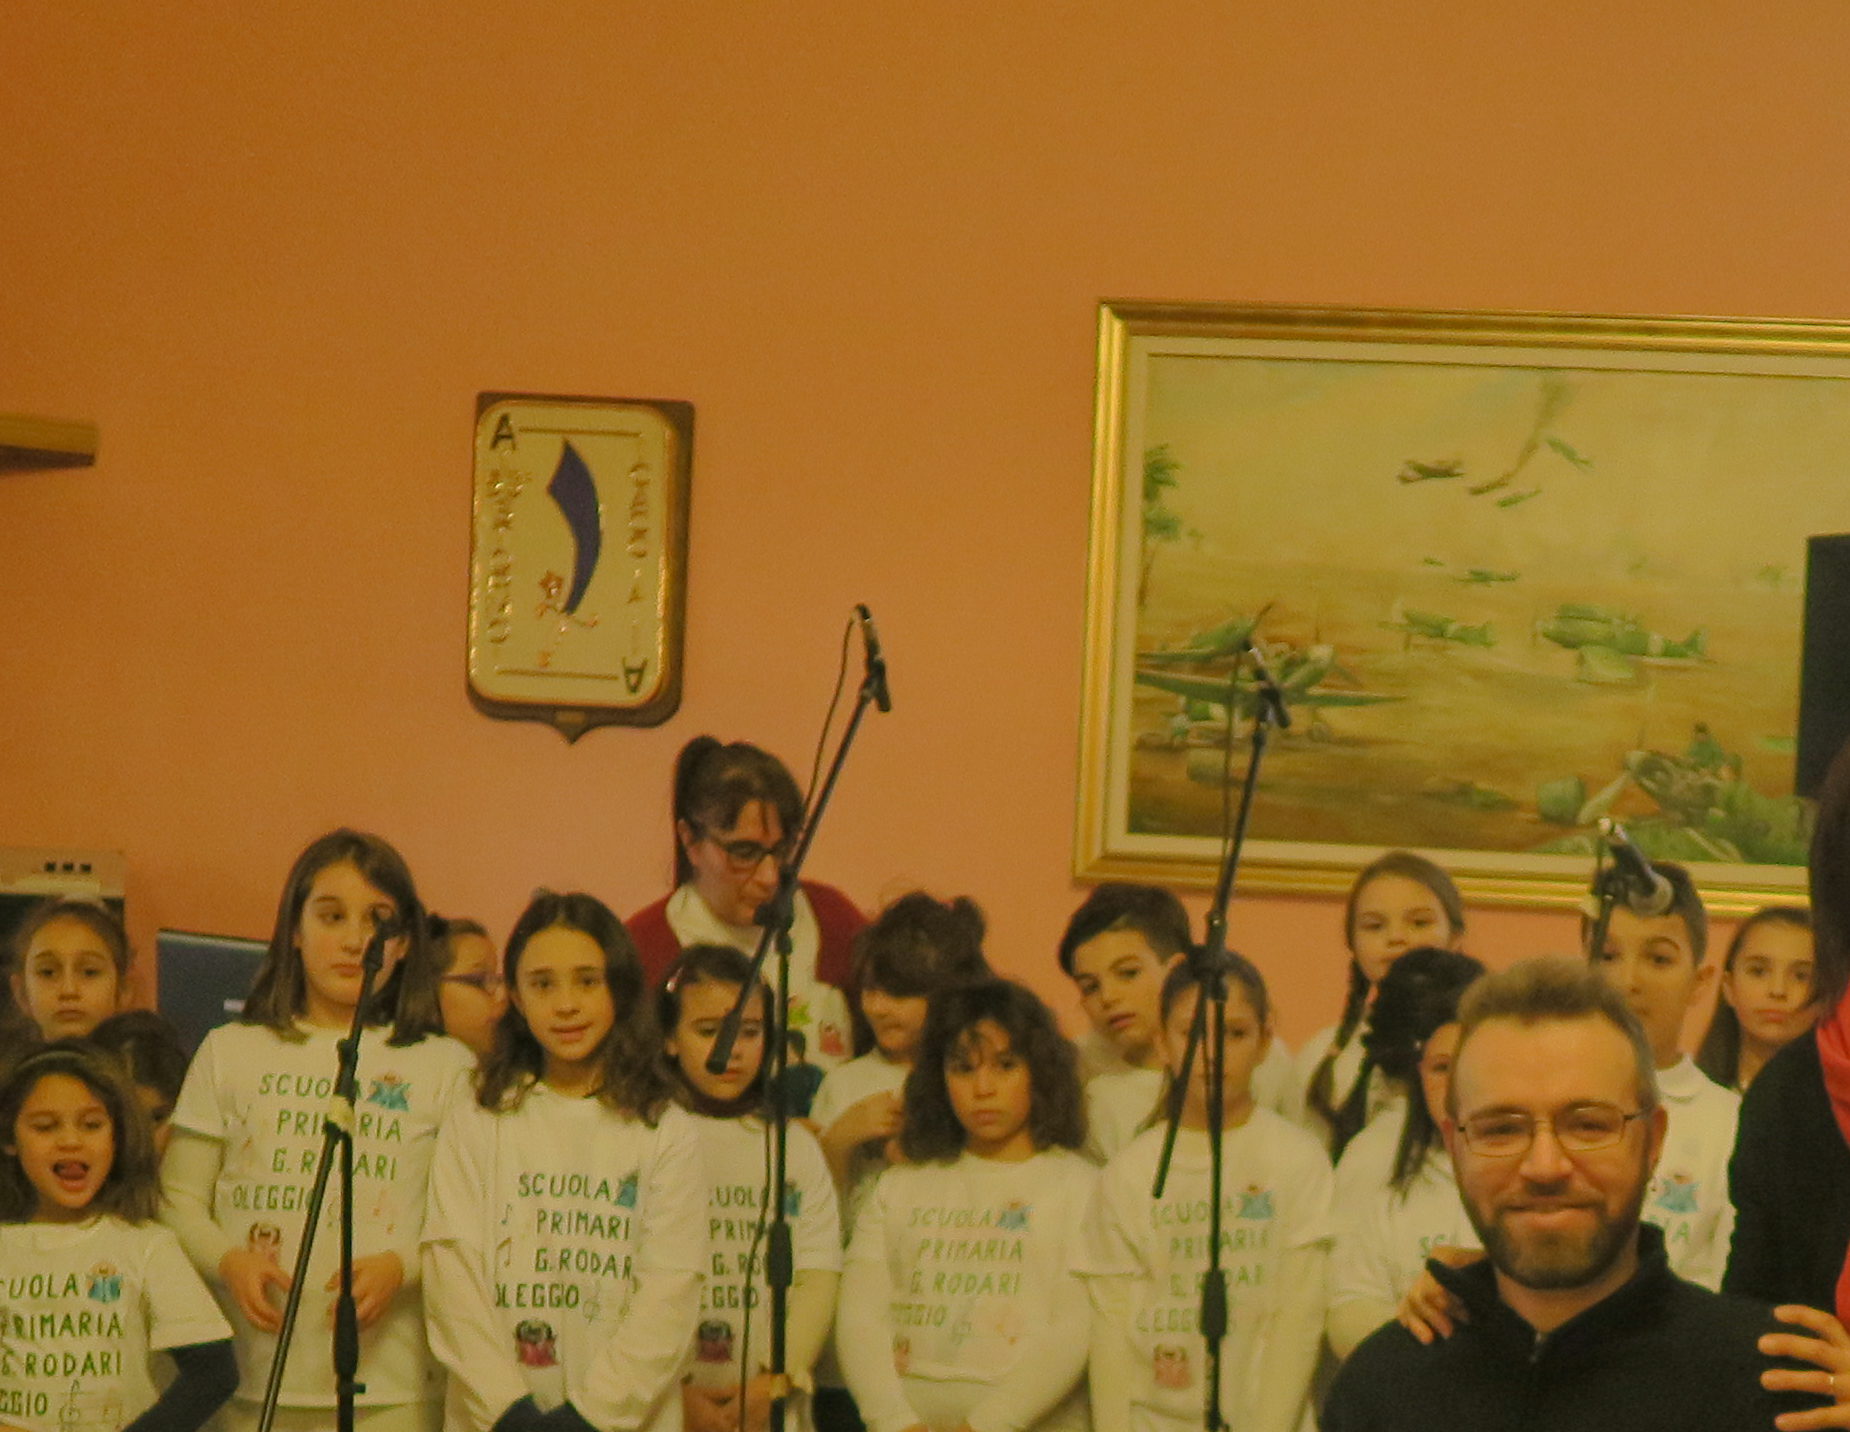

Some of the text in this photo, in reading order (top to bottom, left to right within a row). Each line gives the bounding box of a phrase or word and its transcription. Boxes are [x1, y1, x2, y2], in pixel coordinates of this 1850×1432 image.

[489, 412, 517, 451] A
[259, 1073, 362, 1099] SCUO
[277, 1109, 402, 1144] PRIRIA
[301, 1149, 397, 1180] RARI
[517, 1171, 611, 1202] SCUOLA
[536, 1207, 630, 1242] PRIMARI
[907, 1206, 991, 1229] SCUOLA
[559, 1248, 633, 1280] RODAR
[916, 1237, 1022, 1263] PRIMARIA
[0, 1271, 79, 1300] UOLA
[933, 1271, 1020, 1297] RODARI
[25, 1350, 122, 1377] RODARI
